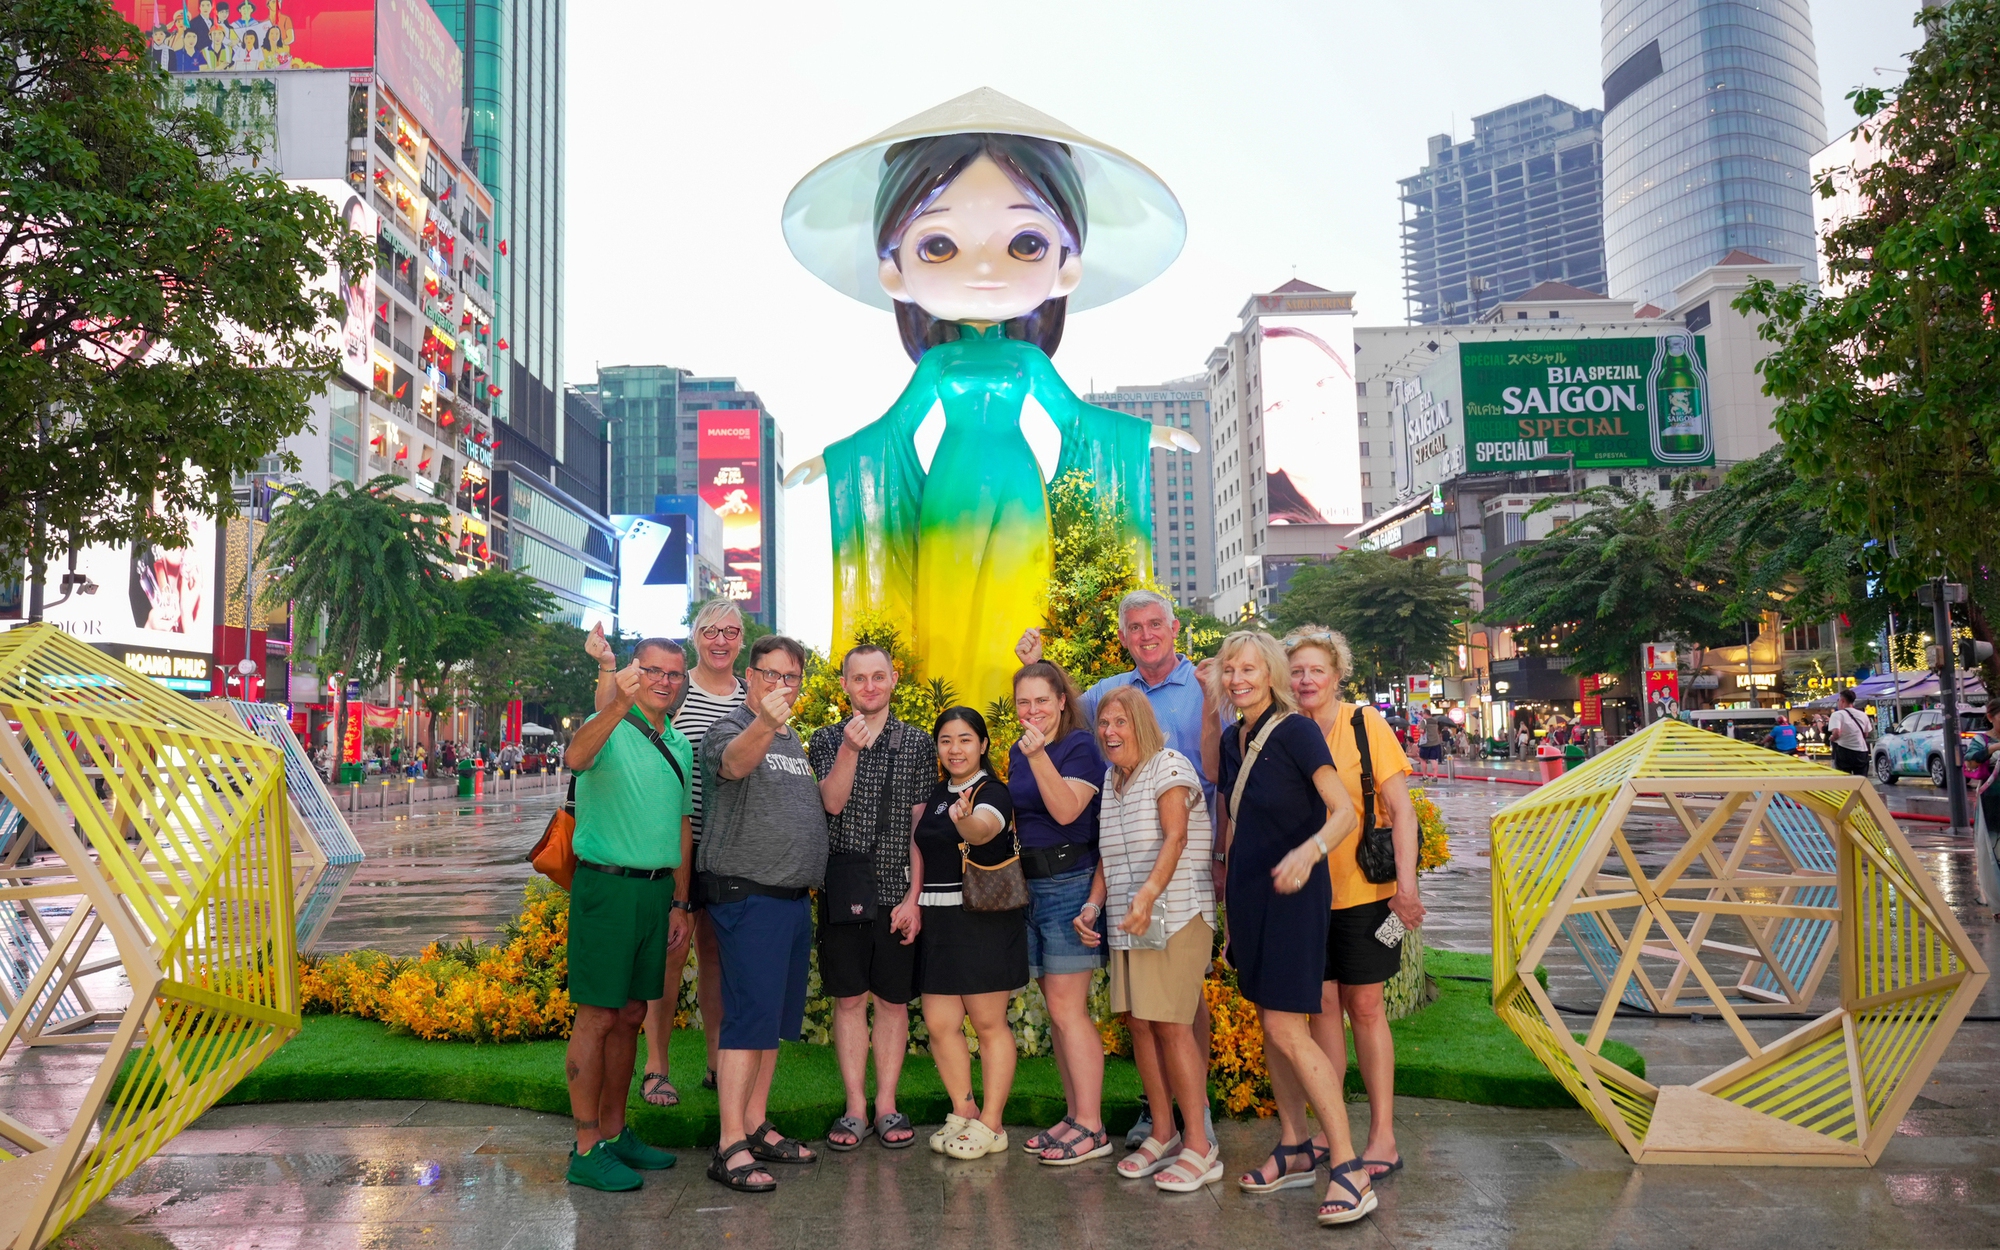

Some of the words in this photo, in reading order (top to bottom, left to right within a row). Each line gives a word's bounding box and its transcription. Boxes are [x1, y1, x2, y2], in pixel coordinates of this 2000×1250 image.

[1286, 297, 1319, 310] SAIGON
[1463, 353, 1506, 367] SPÉCIAL
[1507, 352, 1567, 365] スペシャル
[1547, 366, 1589, 384] BIA
[1588, 365, 1642, 380] SPEZIAL
[1099, 392, 1142, 401] HARBOUR
[1145, 392, 1168, 400] VIEW
[1171, 391, 1203, 400] TOWER
[1420, 391, 1433, 412] BIA
[1502, 384, 1636, 415] SAIGON
[1466, 401, 1502, 416] พิเศษ
[707, 428, 750, 436] MANCODE
[1518, 417, 1629, 438] SPECIAL
[466, 438, 479, 461] THE
[479, 446, 493, 469] ONE
[1415, 434, 1448, 466] SPECIAL
[1381, 525, 1402, 548] GARDEN
[1736, 674, 1777, 688] KATINAT
